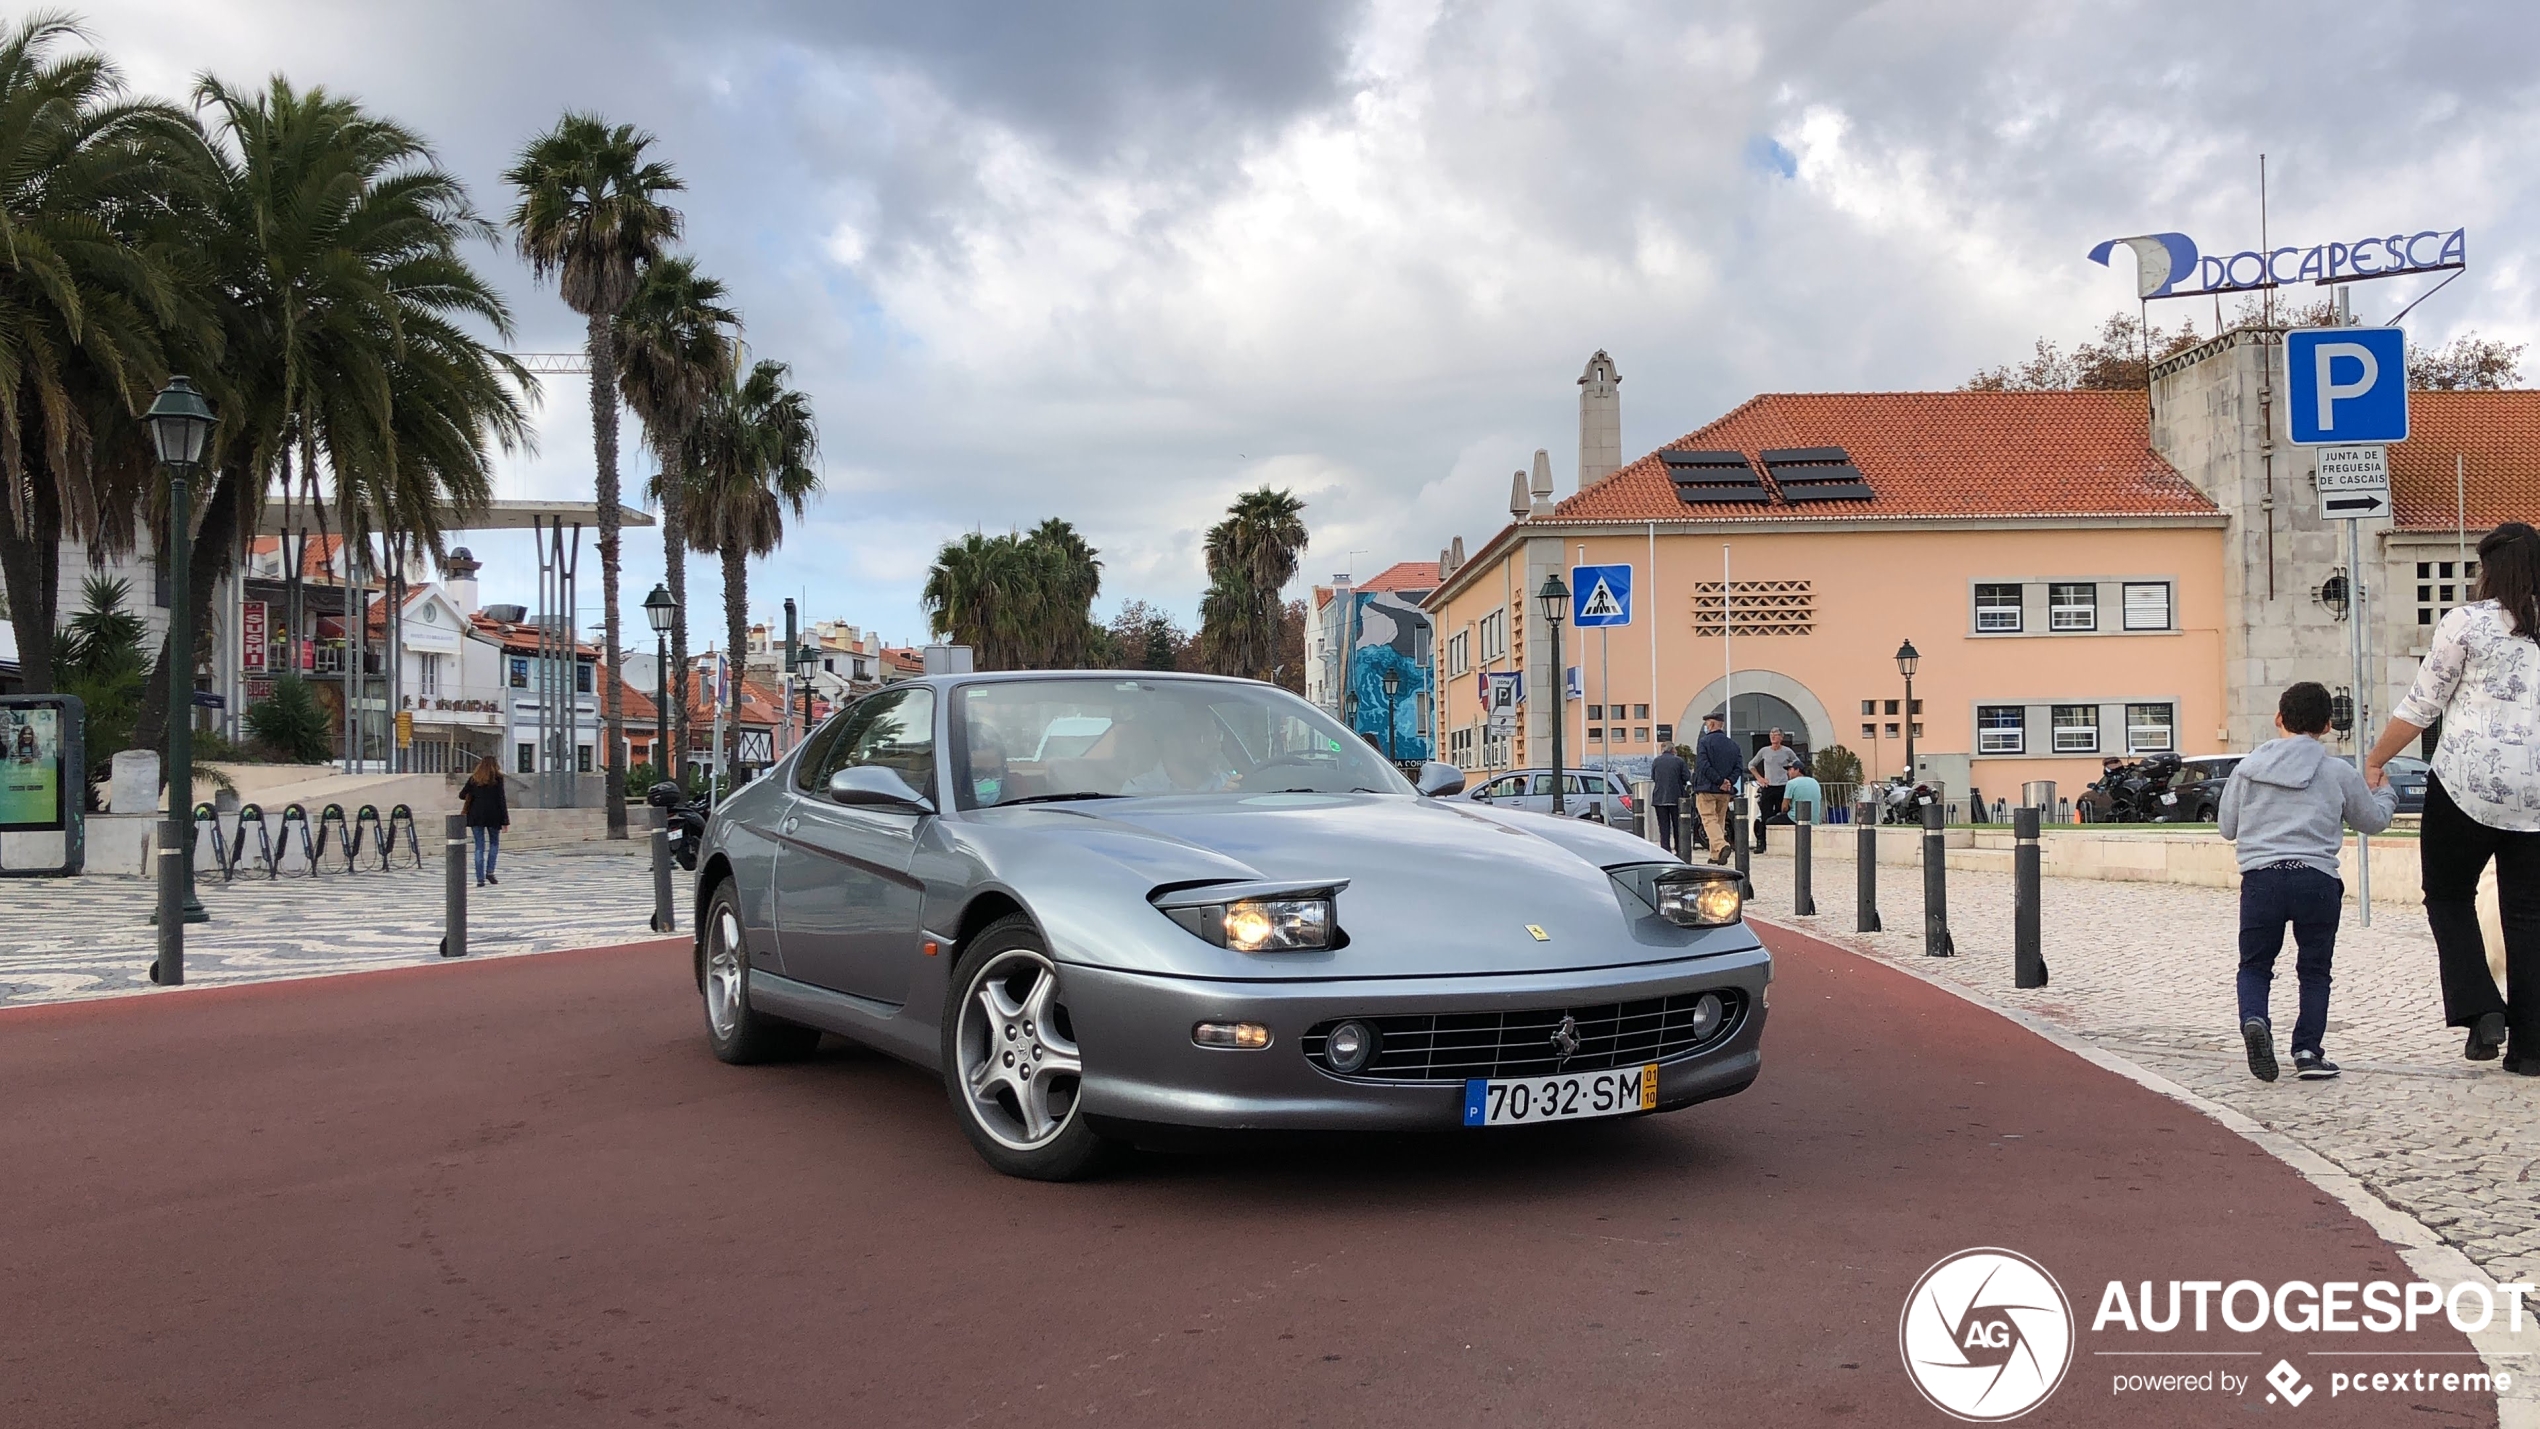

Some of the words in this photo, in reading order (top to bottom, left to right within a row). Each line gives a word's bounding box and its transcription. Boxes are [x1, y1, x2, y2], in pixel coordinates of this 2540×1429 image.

[2202, 227, 2465, 291] DOCAPESCA
[2315, 342, 2379, 431] P
[2325, 452, 2359, 461] JUNTA
[2364, 451, 2378, 460] DE
[2322, 463, 2381, 473] FREGUESIA
[2320, 476, 2334, 485] DE
[2339, 474, 2385, 484] CASCAIS
[245, 614, 263, 664] SUSHI
[1498, 688, 1509, 705] P
[1645, 1069, 1657, 1082] 01
[1645, 1091, 1656, 1104] 10
[1469, 1106, 1478, 1118] P
